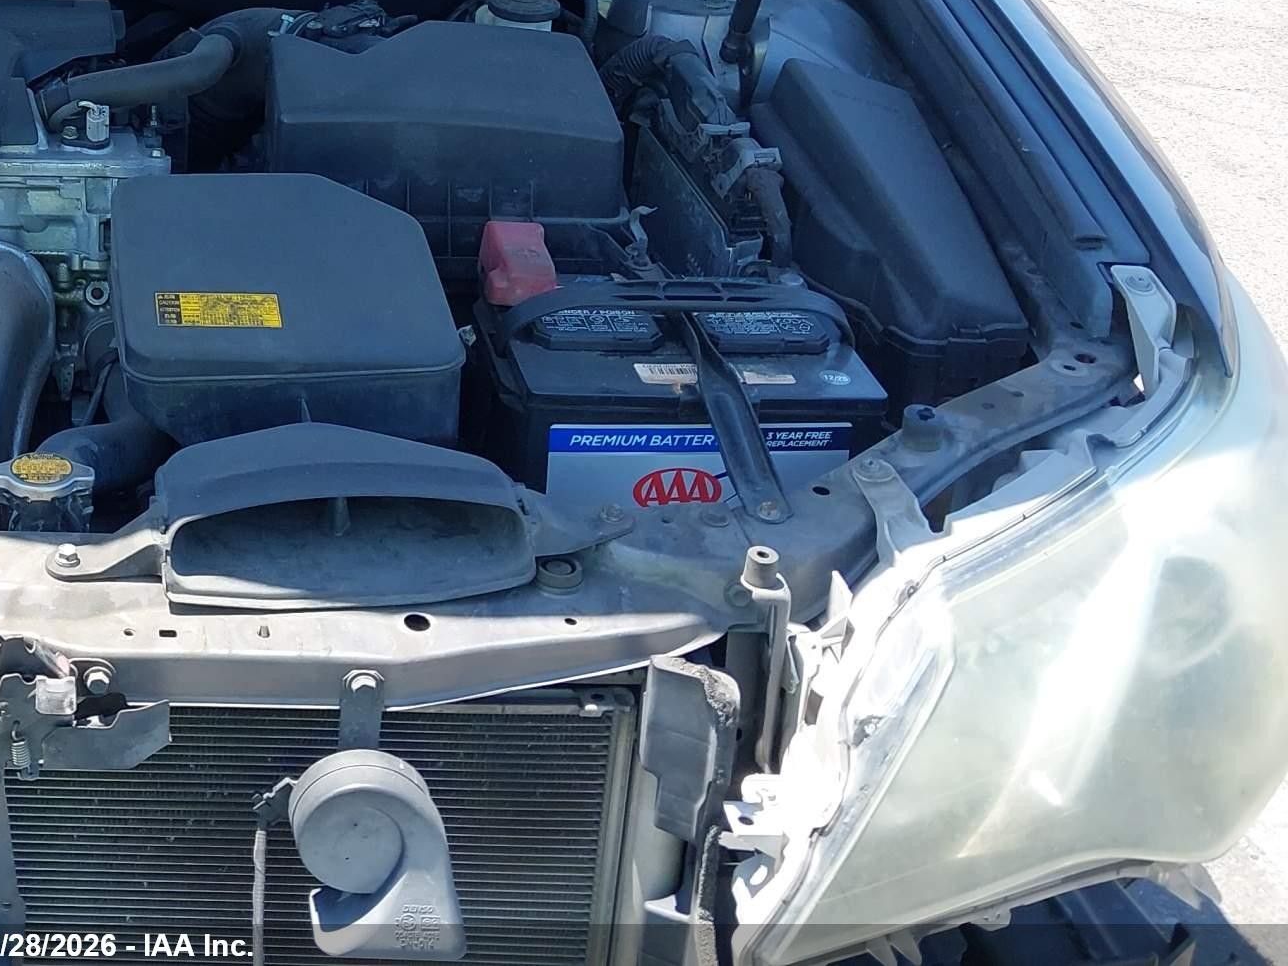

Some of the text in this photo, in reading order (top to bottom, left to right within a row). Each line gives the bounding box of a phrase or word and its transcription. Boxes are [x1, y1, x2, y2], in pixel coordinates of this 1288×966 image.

[569, 434, 718, 446] PREMIUM BATTER
[766, 432, 833, 440] 3 YEAR FREE
[638, 468, 716, 506] AAA
